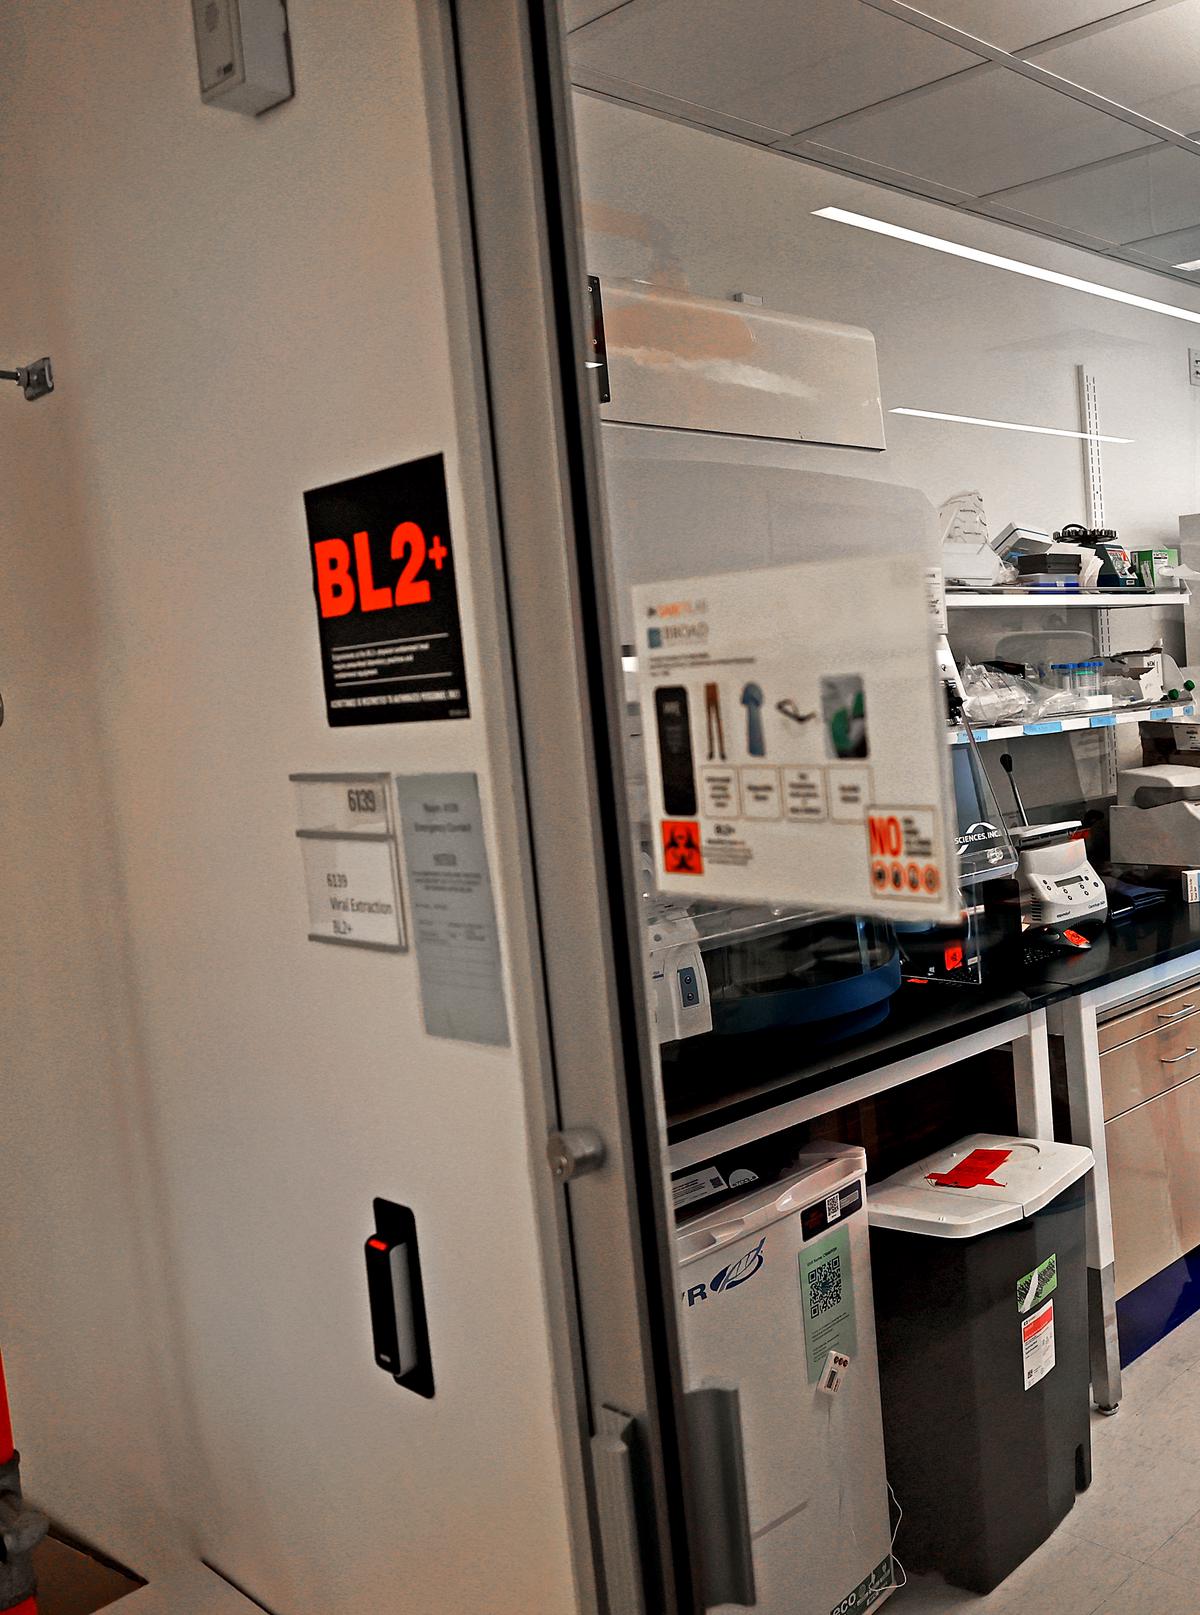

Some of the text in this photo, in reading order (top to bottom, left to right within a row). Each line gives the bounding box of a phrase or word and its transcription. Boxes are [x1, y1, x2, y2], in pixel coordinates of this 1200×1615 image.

[313, 521, 448, 619] BL2+
[347, 789, 376, 813] 6139
[868, 815, 902, 857] NO
[987, 831, 1001, 840] INC.
[326, 873, 348, 887] 6139
[329, 897, 393, 915] Viral Extraction
[332, 919, 353, 935] BL2+
[833, 1592, 856, 1615] eco
